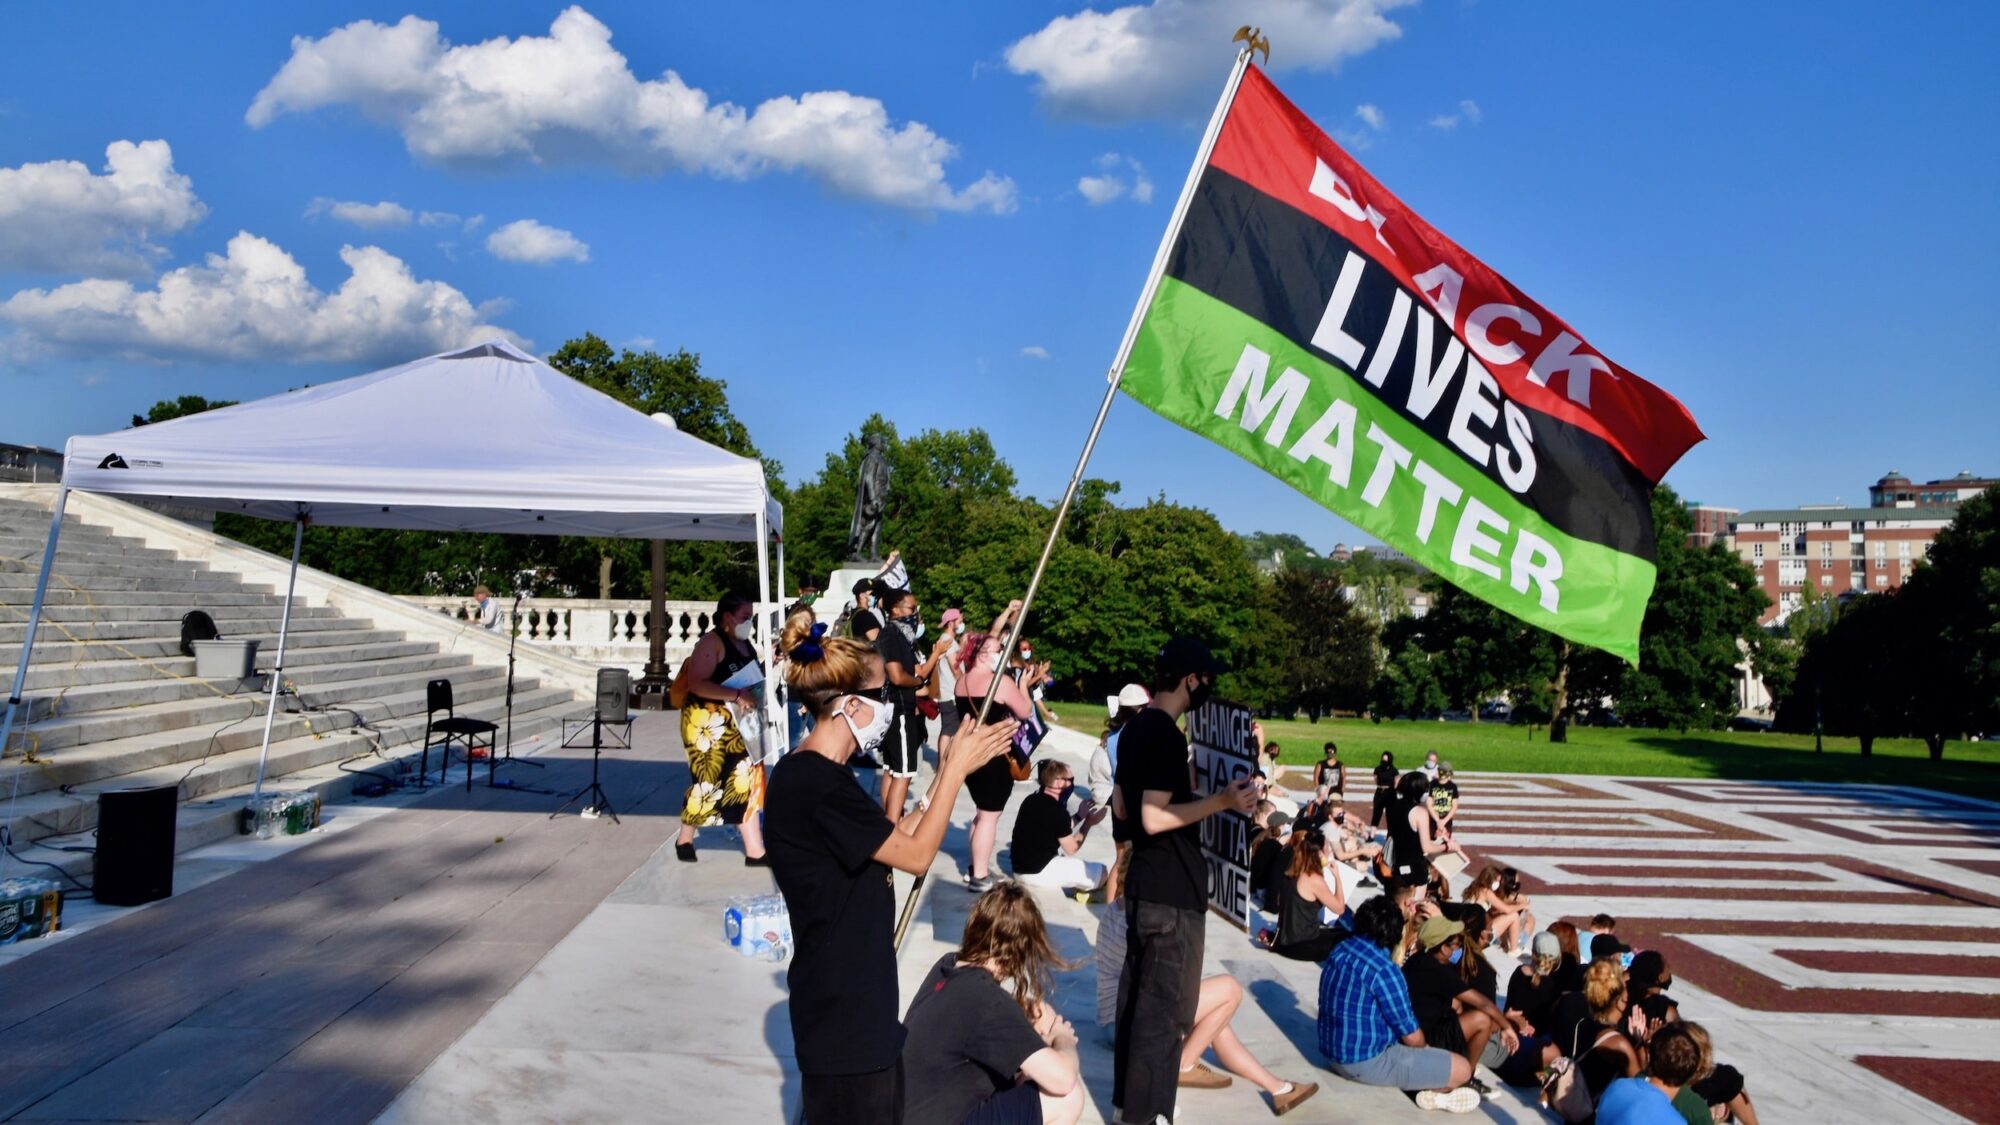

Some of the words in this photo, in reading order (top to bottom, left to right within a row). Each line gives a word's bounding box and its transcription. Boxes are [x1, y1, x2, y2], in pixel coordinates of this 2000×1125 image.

[1310, 250, 1538, 494] LIVES
[1213, 342, 1566, 616] MATTER
[1192, 701, 1250, 757] CHANGE
[1199, 811, 1248, 867] OTTA
[1206, 857, 1248, 921] OME
